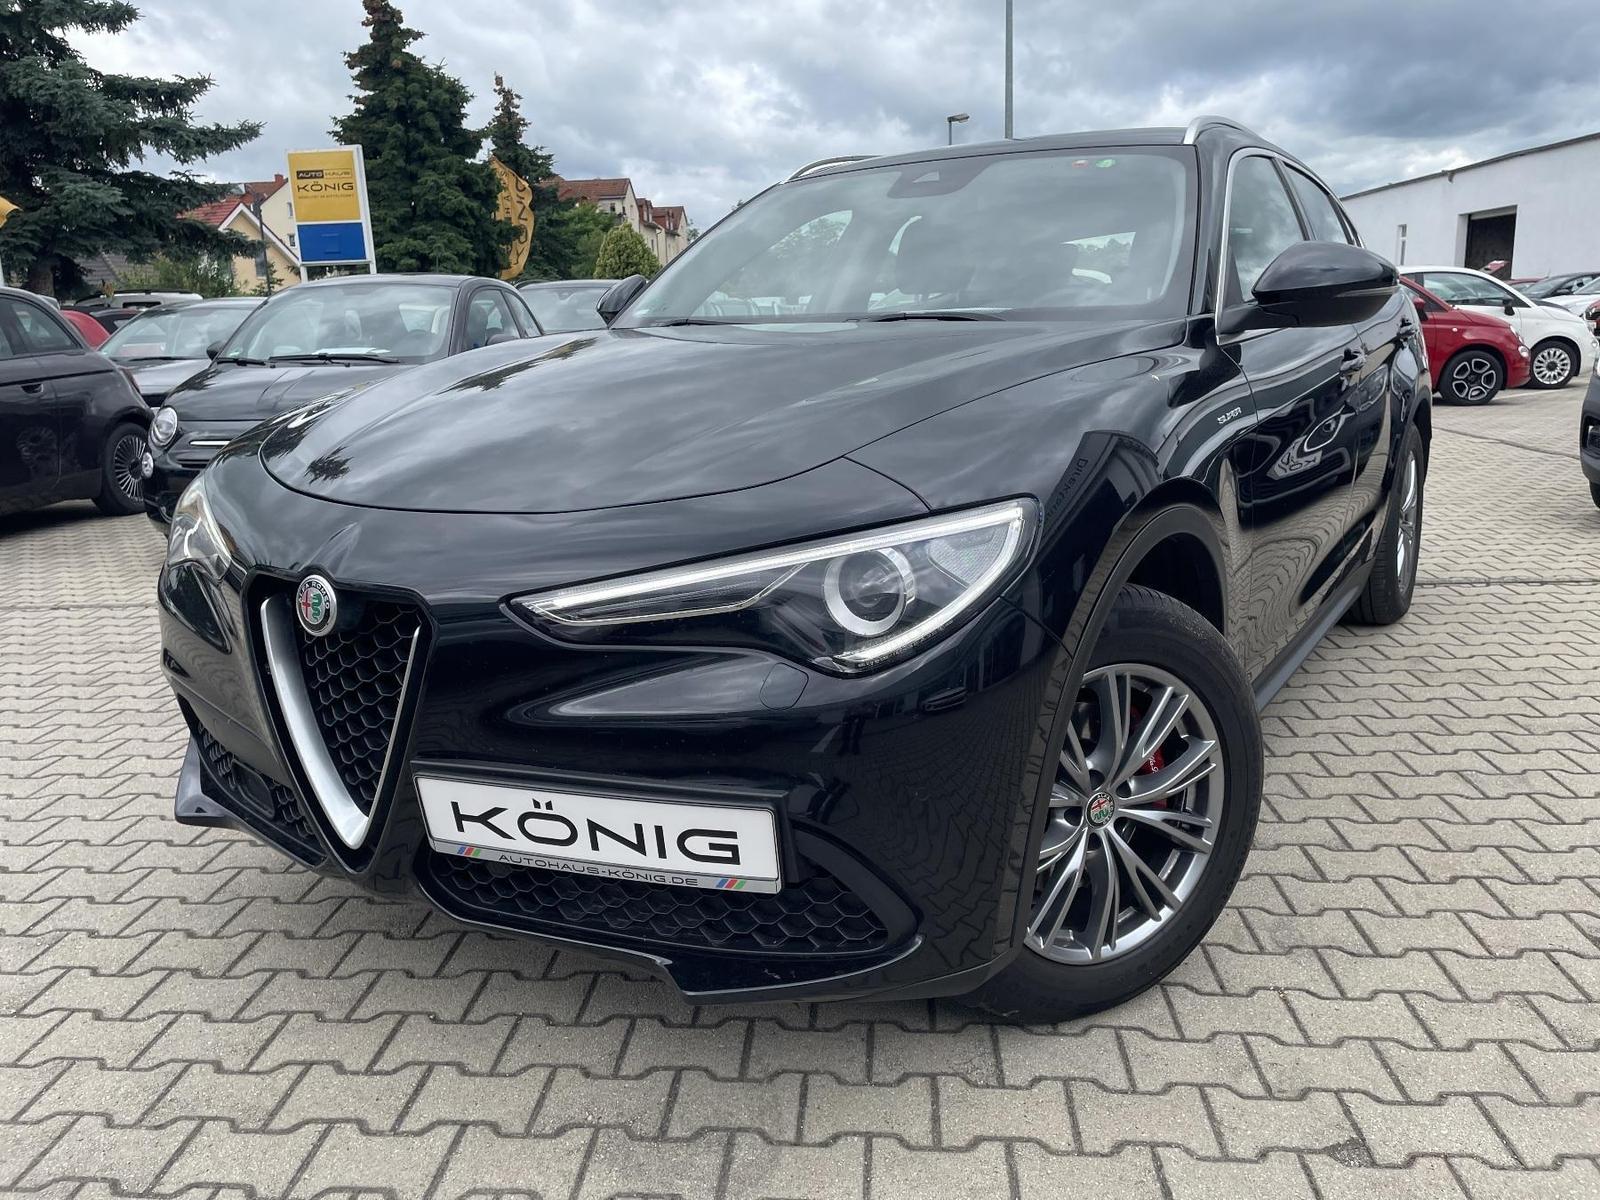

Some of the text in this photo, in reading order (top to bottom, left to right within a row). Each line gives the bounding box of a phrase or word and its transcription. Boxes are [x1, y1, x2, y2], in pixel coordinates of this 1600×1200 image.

[297, 181, 354, 192] KÖNIG
[1217, 406, 1242, 424] SUPER
[311, 581, 330, 609] ROMEO
[450, 798, 741, 866] KÖNIG
[499, 854, 699, 886] AUTOHAUS-KÖNIG.DE
